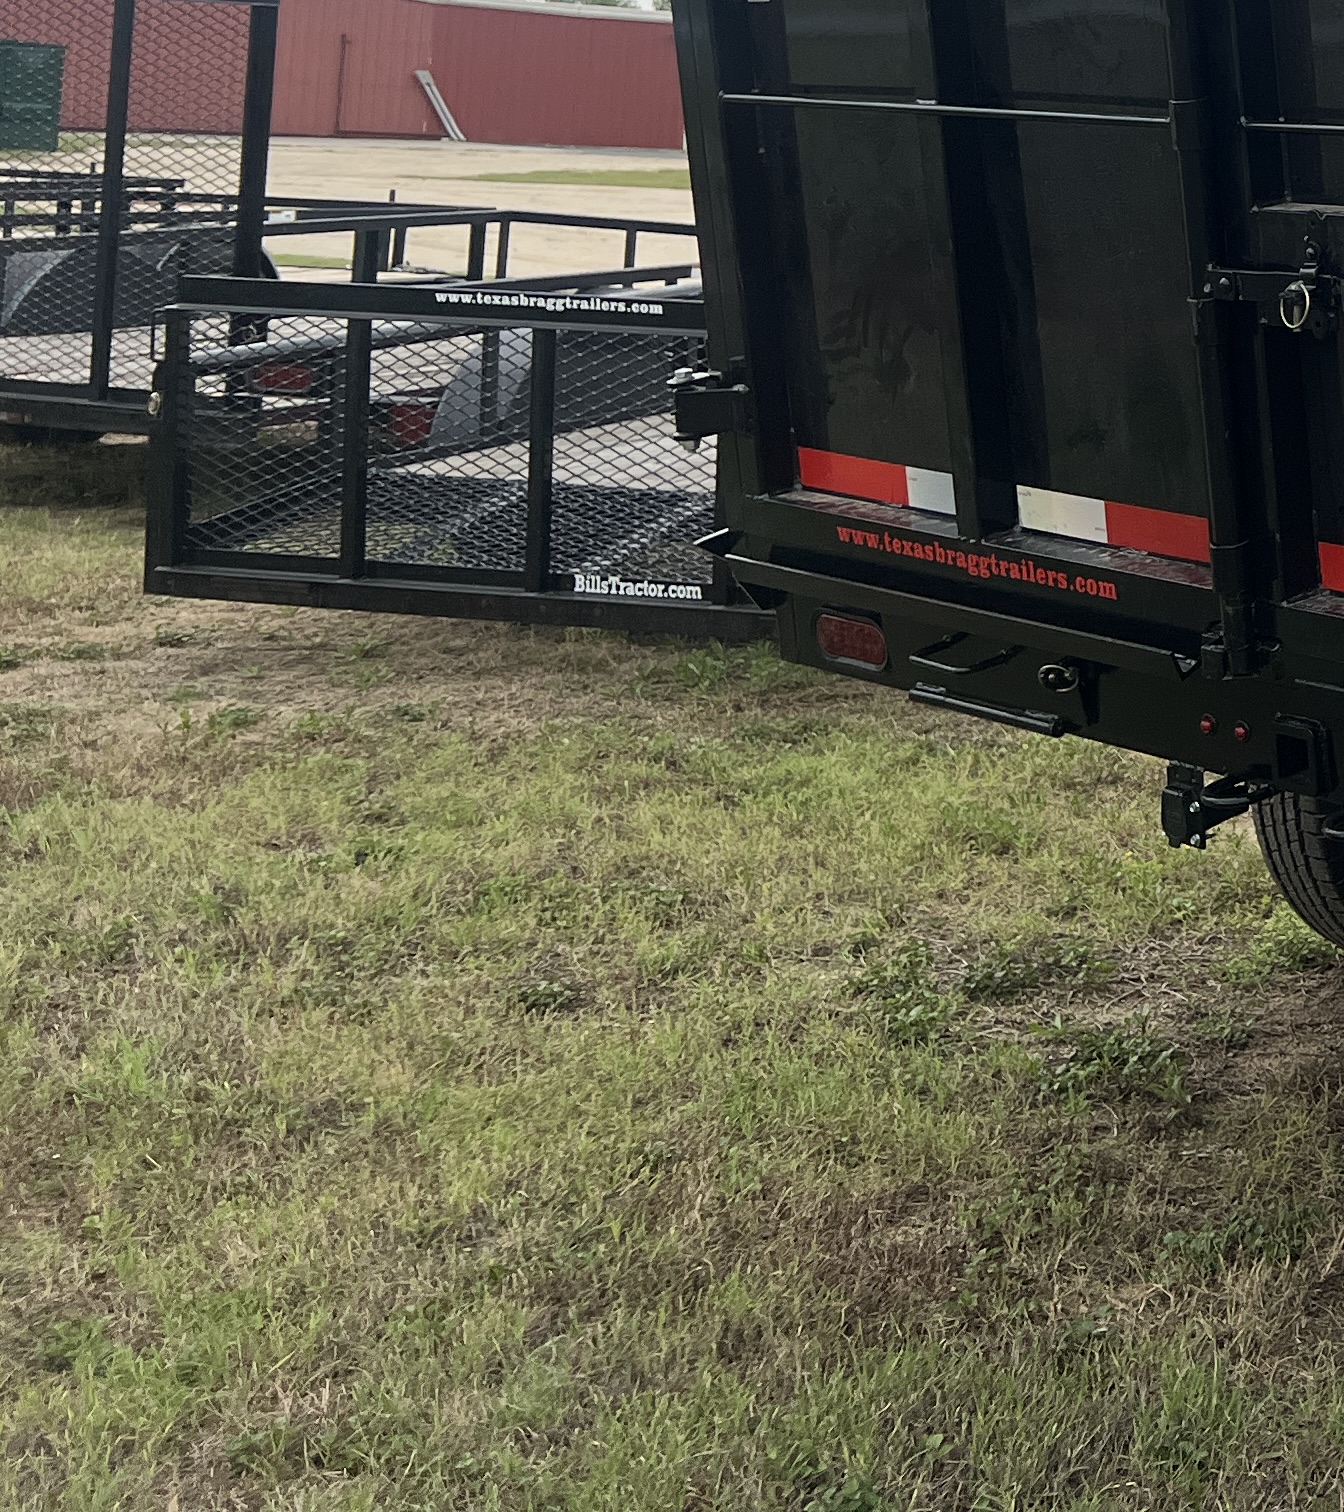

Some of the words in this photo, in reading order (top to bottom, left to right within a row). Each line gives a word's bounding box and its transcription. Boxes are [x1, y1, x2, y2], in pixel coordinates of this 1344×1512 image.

[435, 291, 664, 315] www.texasbraggtrailers.com
[836, 525, 1118, 601] www.texasbraggtrailers.com
[573, 574, 703, 600] BillsTractor.com
